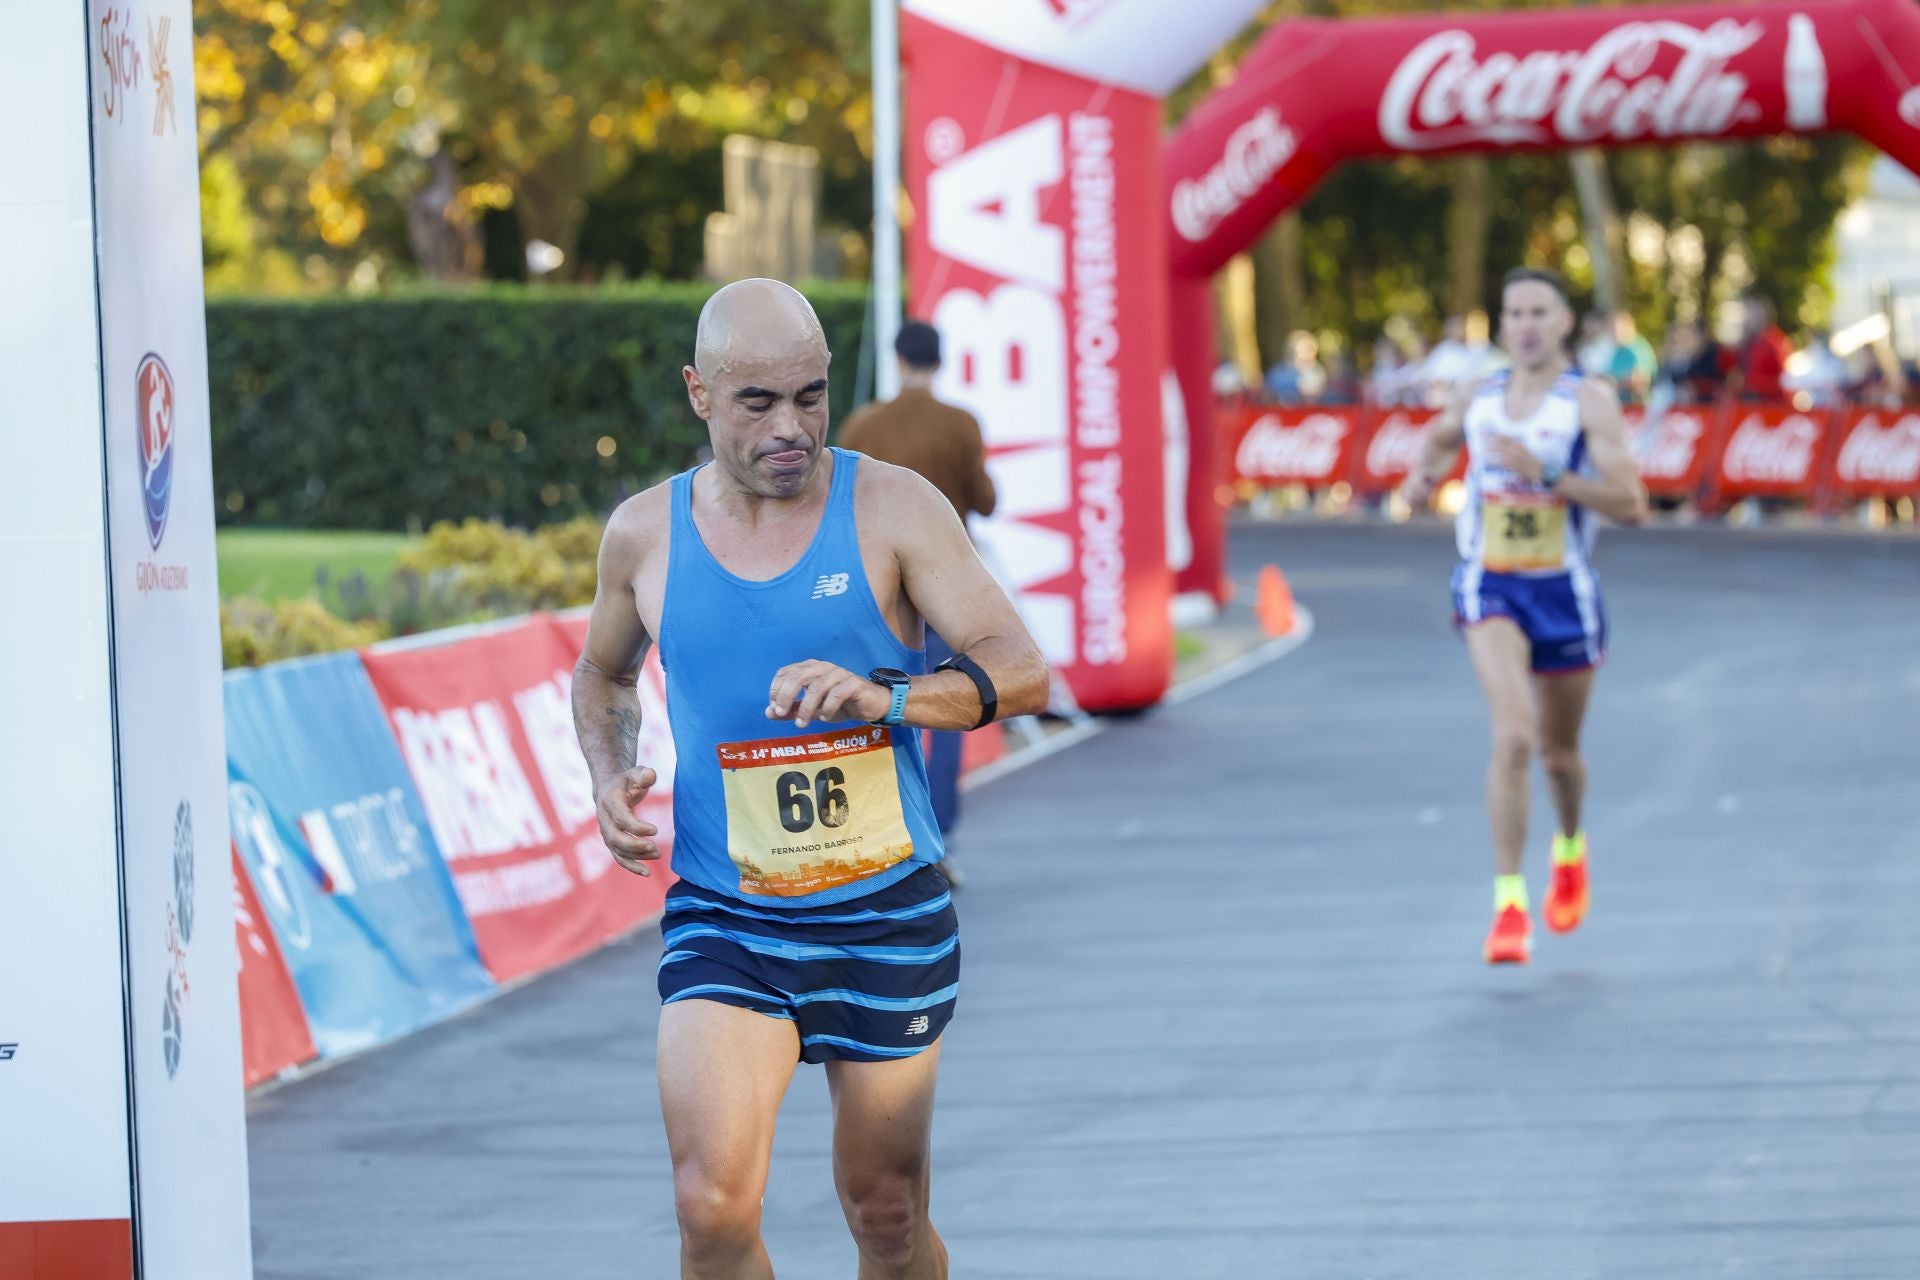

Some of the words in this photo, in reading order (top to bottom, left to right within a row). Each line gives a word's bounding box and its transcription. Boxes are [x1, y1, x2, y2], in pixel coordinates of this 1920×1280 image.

[1068, 112, 1121, 448] EMPOWERMENT
[1078, 451, 1128, 664] SURGICAL
[771, 745, 807, 758] MBA
[833, 735, 868, 750] GIJÓN
[776, 767, 849, 833] 66
[771, 844, 822, 855] FERNANDO
[824, 836, 864, 849] BARROSO
